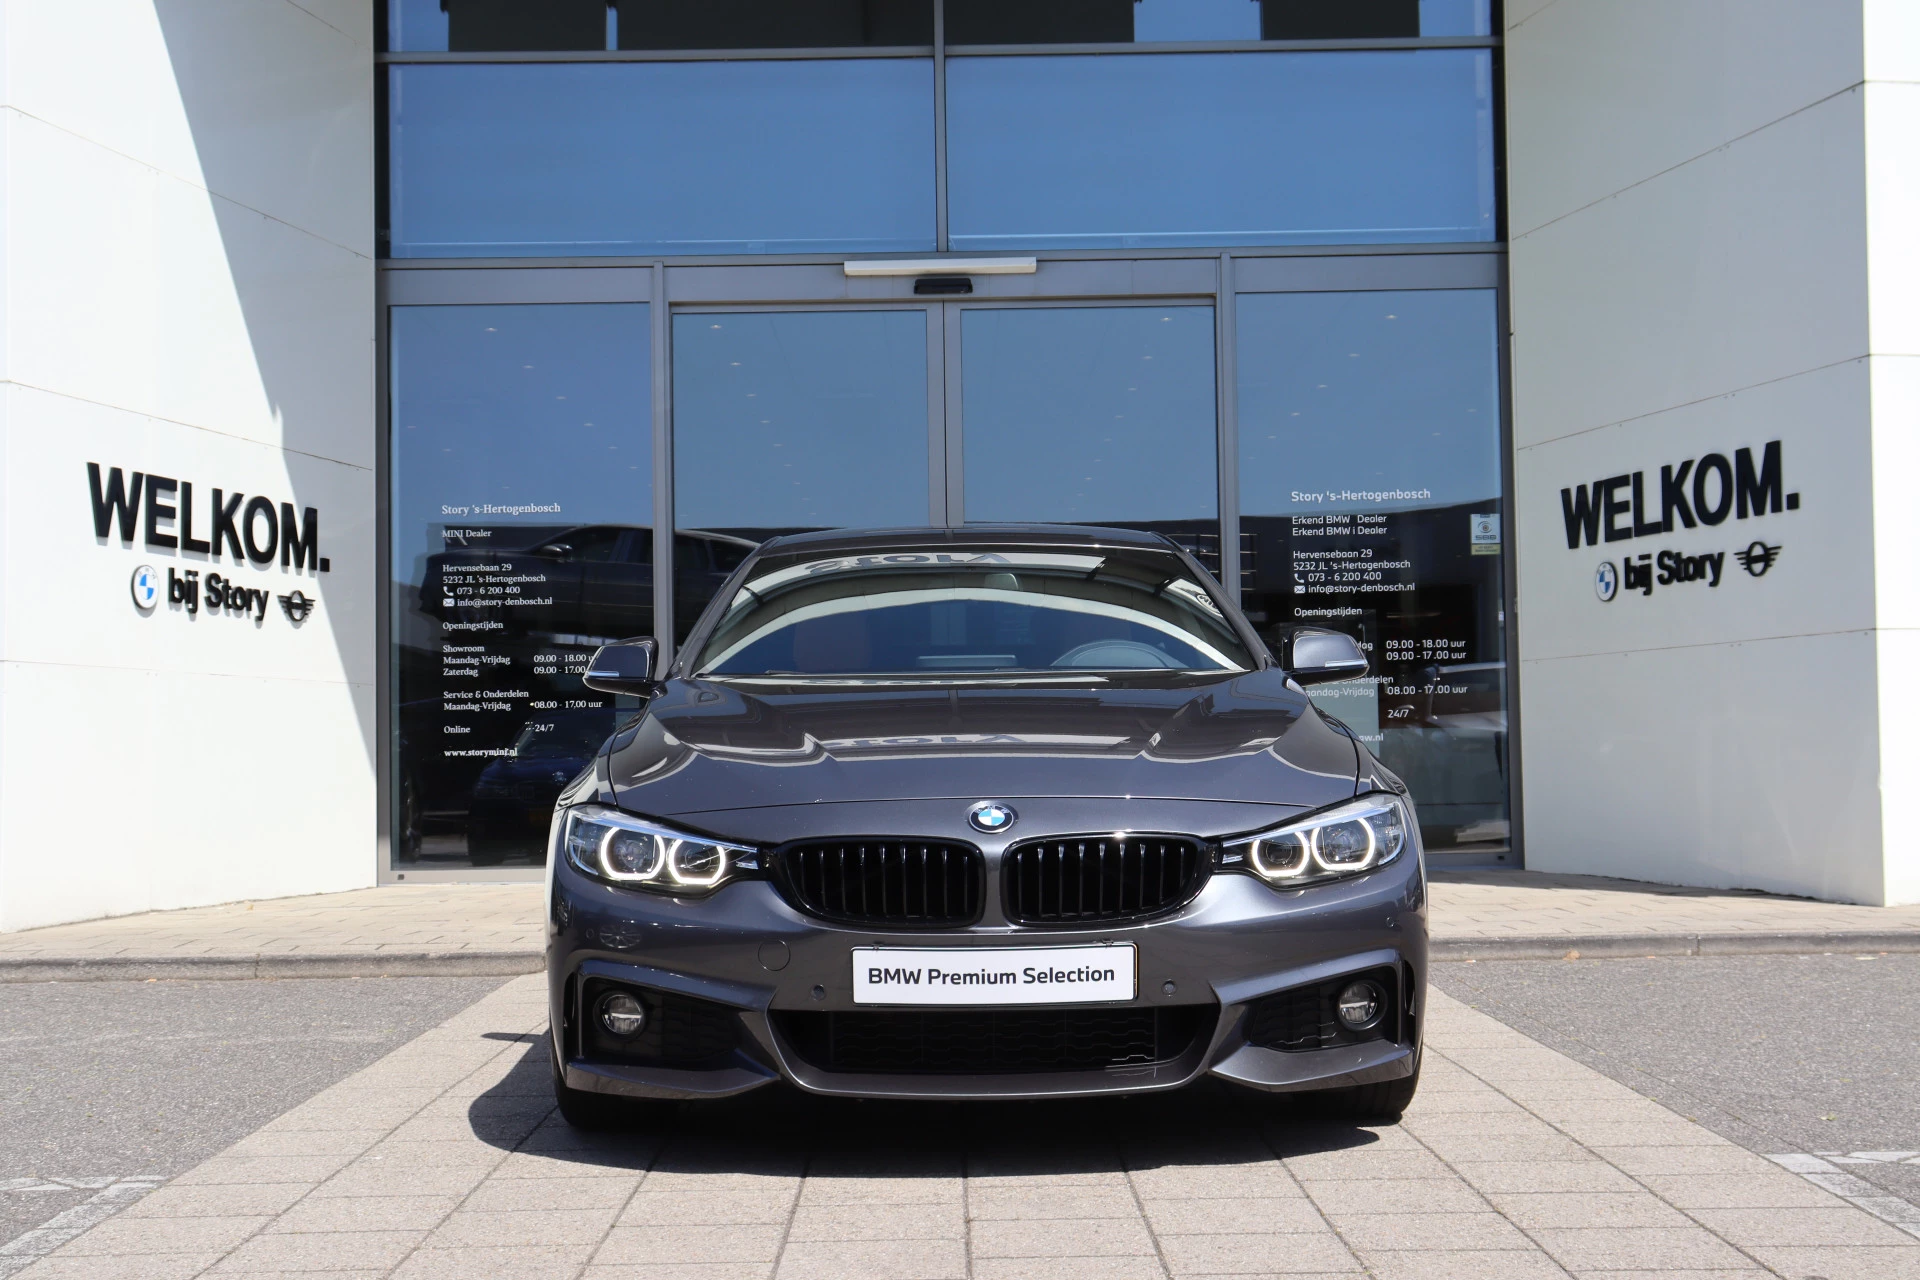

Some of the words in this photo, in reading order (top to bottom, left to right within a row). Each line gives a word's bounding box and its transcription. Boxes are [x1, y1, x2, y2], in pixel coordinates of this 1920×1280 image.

[1292, 491, 1323, 503] Story
[1326, 488, 1430, 502] 's-Hertogenbosch
[1561, 440, 1800, 549] WELKOM.
[441, 505, 470, 516] Story
[87, 462, 330, 572] WELKOM.
[1292, 516, 1324, 525] Erkend
[1326, 516, 1350, 524] BMW
[1357, 515, 1387, 524] Dealer
[442, 529, 464, 538] MINI
[1292, 528, 1324, 536] Erkend
[1326, 526, 1350, 535] BMW
[1358, 526, 1388, 534] Dealer
[1293, 550, 1358, 559] Hervensebaan
[1361, 549, 1372, 558] 29
[443, 564, 500, 572] Hervensebaan
[1294, 562, 1316, 571] 5232
[1318, 562, 1328, 570] JL
[1308, 573, 1326, 582] 073
[1334, 573, 1340, 581] 6
[1342, 572, 1361, 581] 200
[1363, 572, 1382, 580] 400
[1624, 554, 1652, 596] bij
[1657, 550, 1725, 587] Story
[443, 576, 463, 584] 5232
[456, 586, 472, 594] 073
[504, 586, 520, 594] 400
[1308, 582, 1416, 594] info@story-denbosch.nl
[168, 567, 198, 614] bij
[204, 572, 270, 622] Story
[457, 597, 552, 608] info@story-denbosch.nl
[1294, 607, 1362, 618] Openingstijden
[442, 621, 504, 631] Openingstijden
[1386, 640, 1414, 648] 09.00
[1422, 639, 1448, 648] 18.00
[443, 655, 511, 666] Maandag-Vrijdag
[1386, 652, 1414, 660] 09.00
[443, 668, 478, 677] Zaterdag
[534, 666, 556, 674] 09.00
[444, 691, 474, 699] Service
[482, 690, 529, 698] Onderdelen
[1387, 686, 1416, 695] 08.00
[1452, 686, 1468, 694] uur
[444, 702, 512, 712] Maandag-Vrijdag
[534, 701, 558, 709] 08.00
[1387, 710, 1409, 718] 24/7
[534, 724, 554, 732] 24/7
[868, 968, 921, 985] BMW
[928, 968, 1016, 985] Premium
[1023, 966, 1115, 984] Selection
